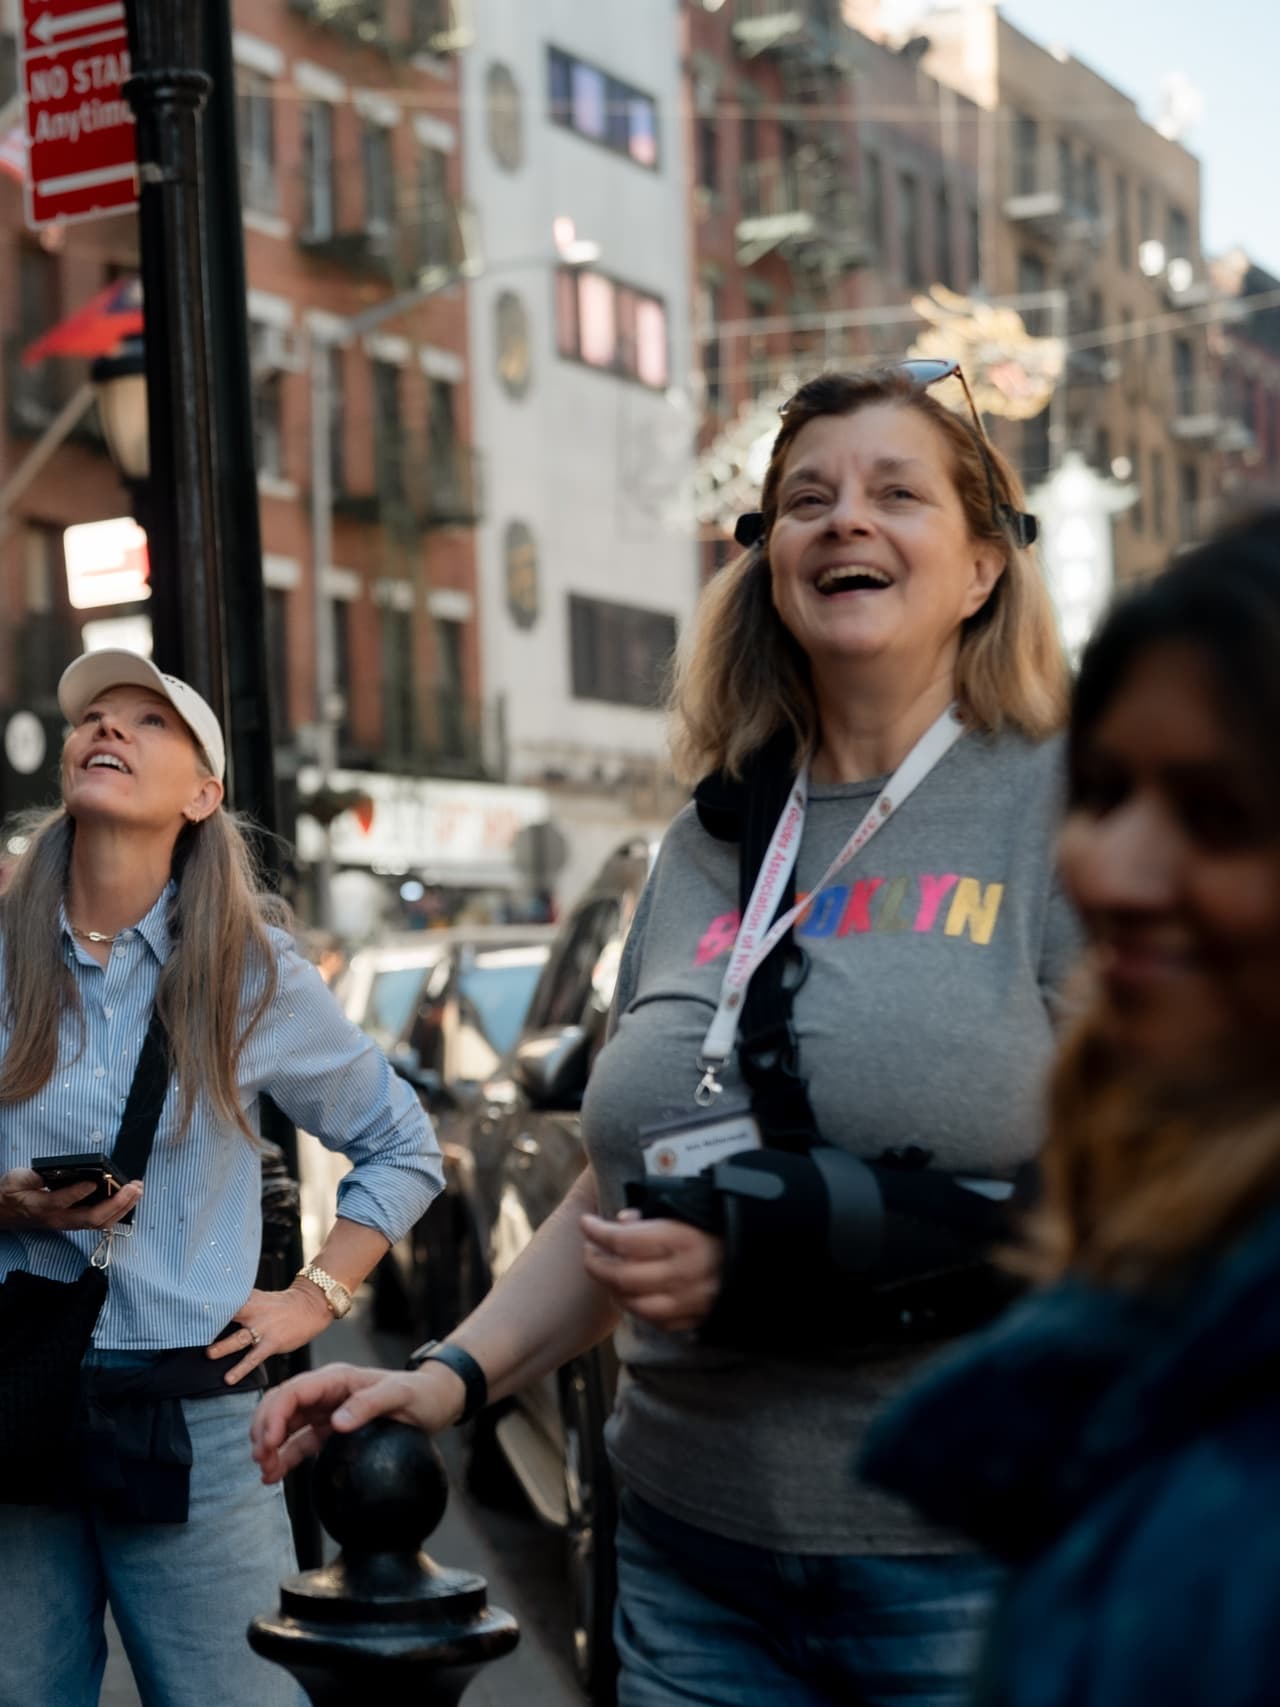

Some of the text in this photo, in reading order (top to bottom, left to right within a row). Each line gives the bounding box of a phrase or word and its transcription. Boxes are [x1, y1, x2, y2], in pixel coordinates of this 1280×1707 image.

[30, 65, 69, 104] NO
[692, 872, 1005, 967] BOKLYN
[747, 850, 787, 931] Association
